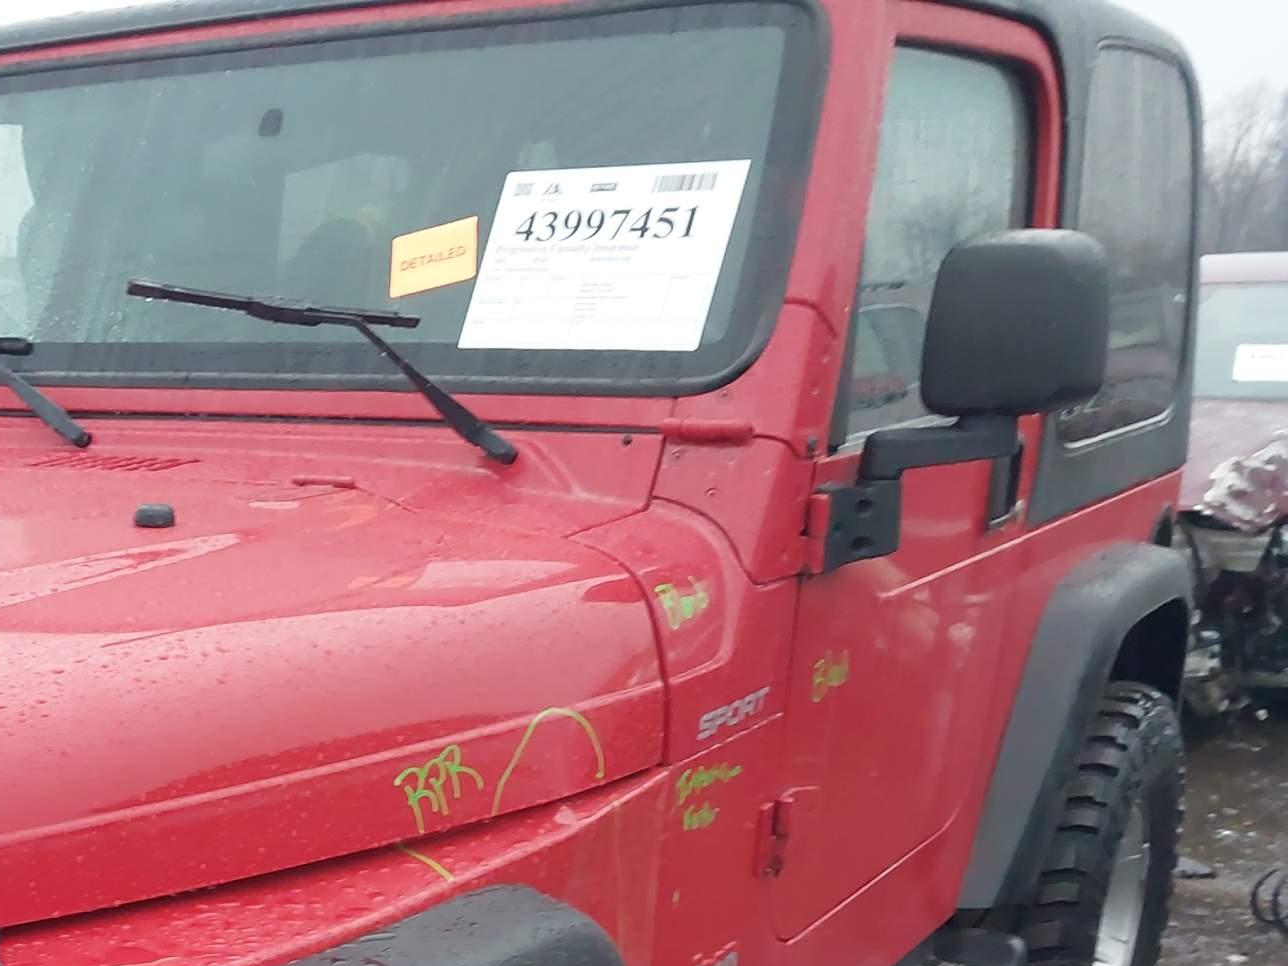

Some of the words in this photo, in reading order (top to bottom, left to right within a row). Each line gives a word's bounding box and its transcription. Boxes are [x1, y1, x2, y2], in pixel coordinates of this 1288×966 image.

[515, 204, 700, 242] 43997451
[400, 245, 467, 272] DETAILED
[696, 686, 771, 741] SPORT
